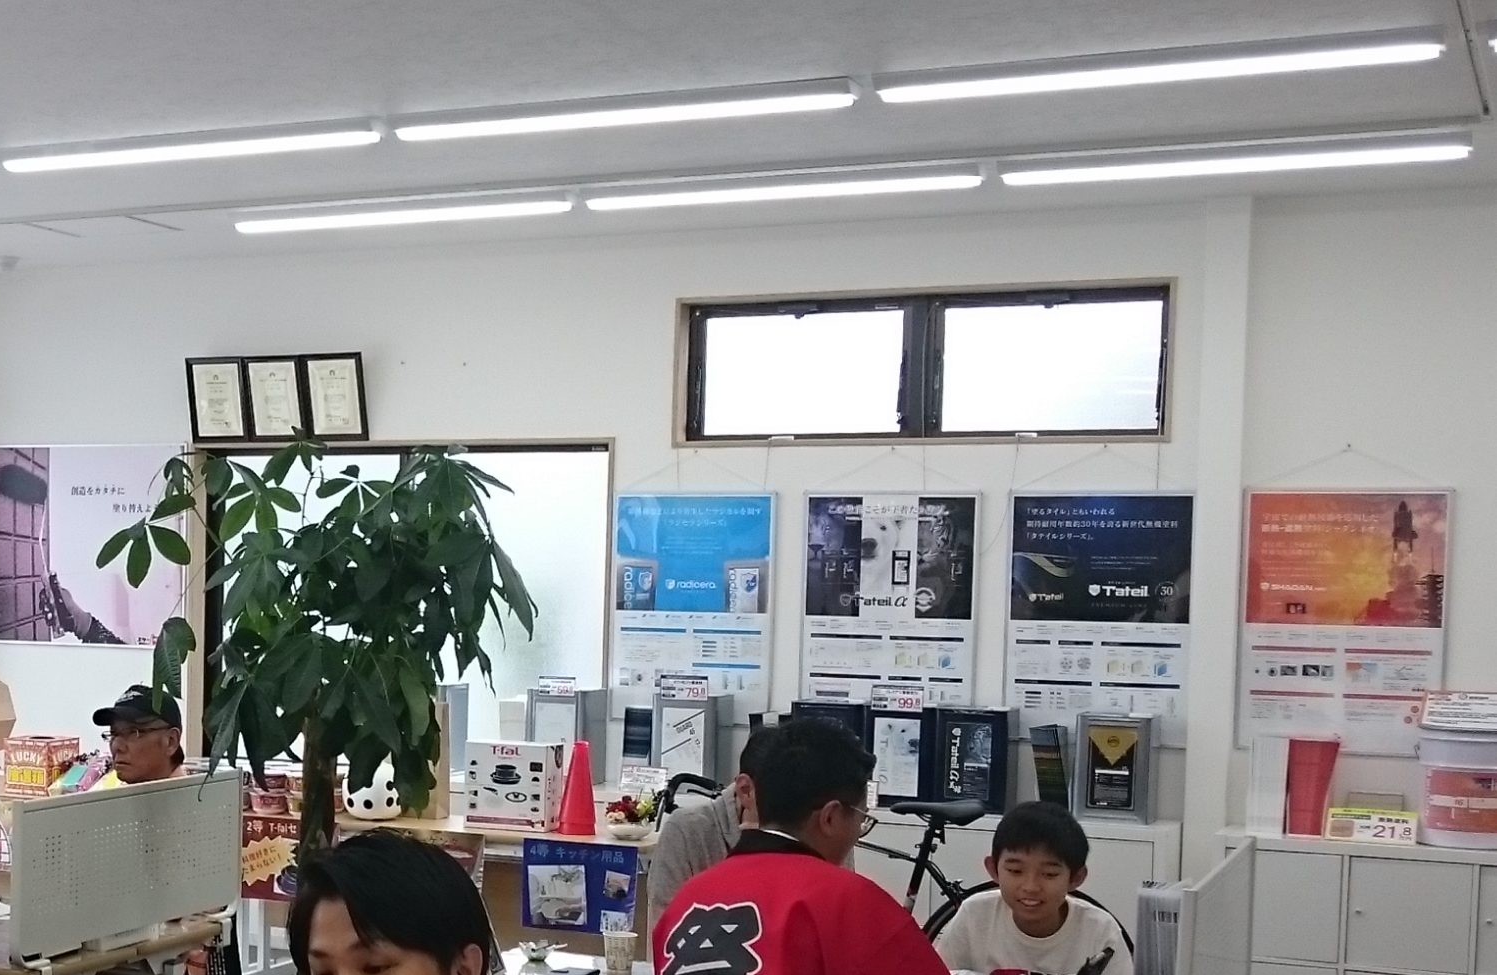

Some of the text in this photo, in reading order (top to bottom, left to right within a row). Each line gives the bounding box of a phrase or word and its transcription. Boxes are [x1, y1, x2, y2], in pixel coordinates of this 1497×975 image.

[71, 486, 125, 496] 創造をカタチに
[1160, 586, 1173, 596] 30
[10, 750, 44, 765] LUCKY
[246, 820, 264, 833] 2等
[530, 843, 624, 863] 4等 キッチン用品
